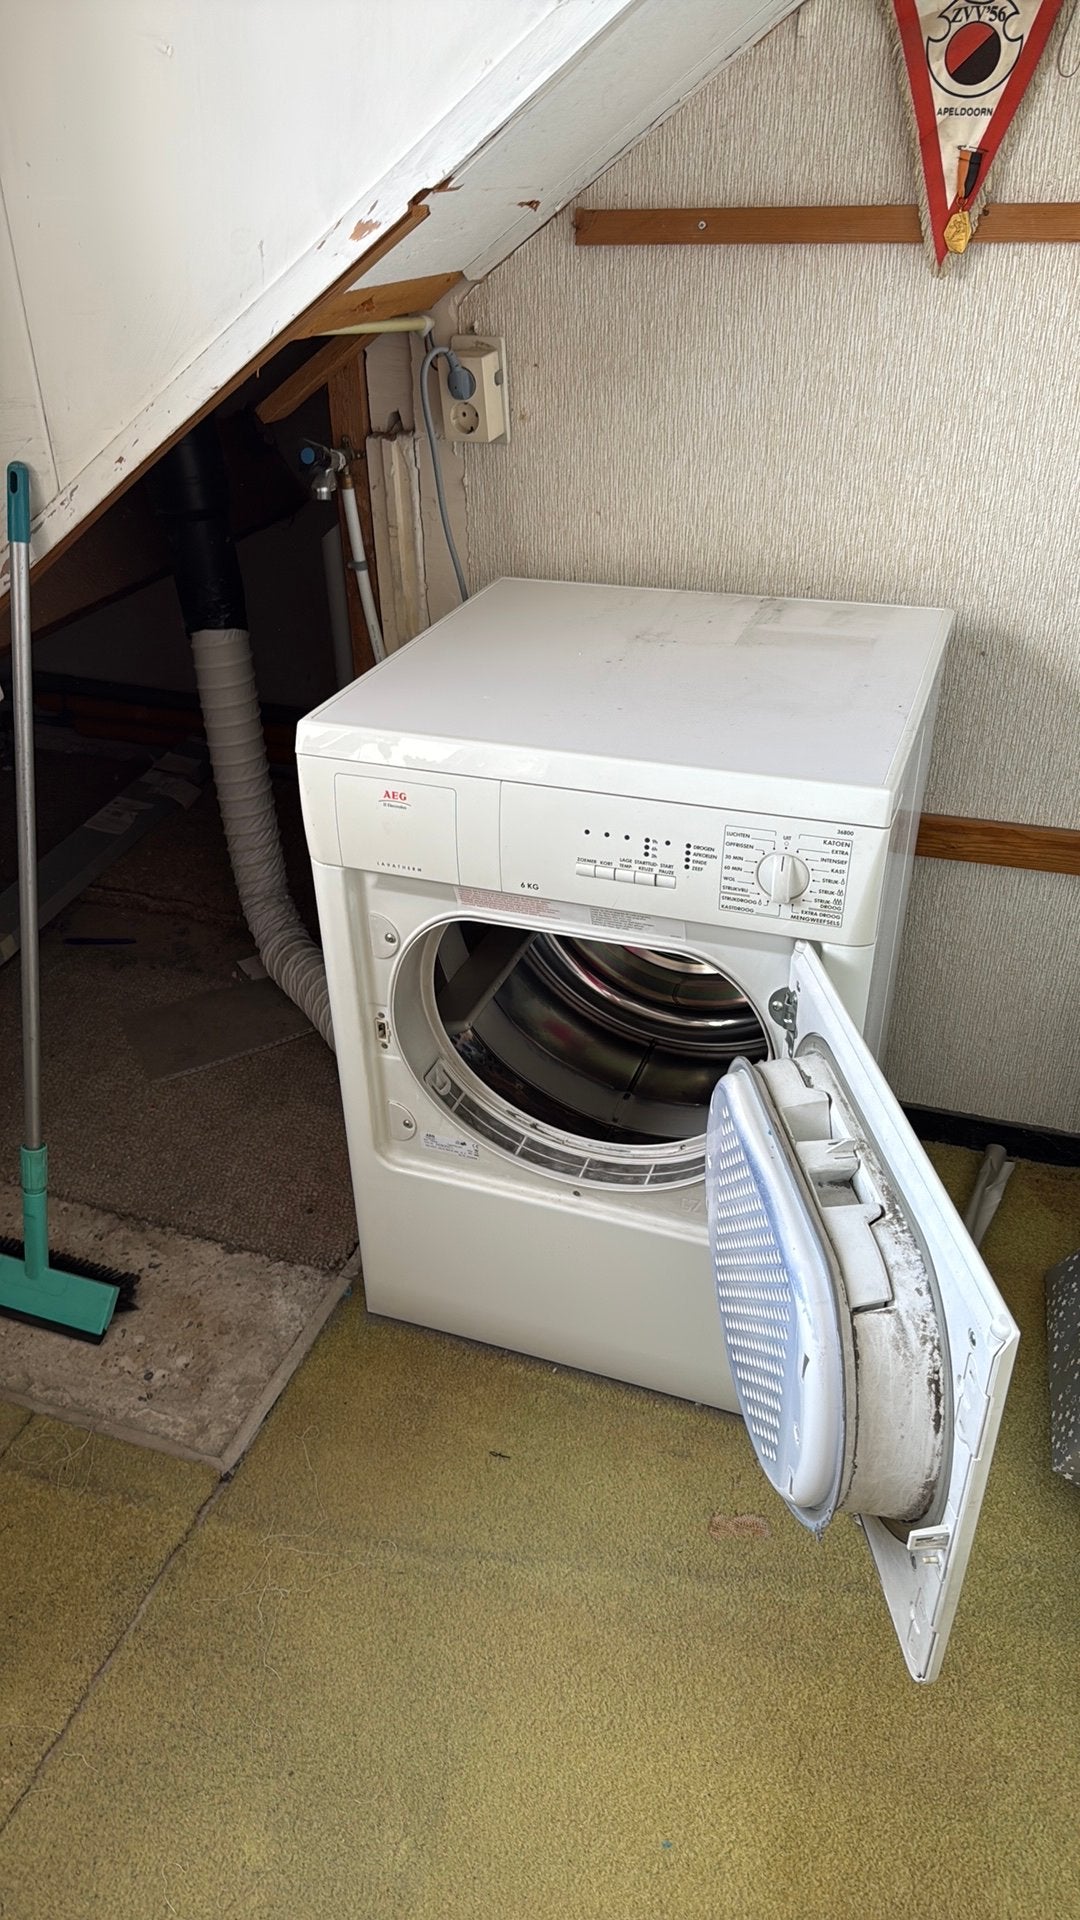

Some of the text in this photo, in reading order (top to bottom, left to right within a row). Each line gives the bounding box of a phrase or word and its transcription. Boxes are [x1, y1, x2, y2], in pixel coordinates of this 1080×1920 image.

[950, 5, 1007, 22] ZVV'56
[937, 107, 993, 116] APELDOORN
[384, 790, 407, 800] AEG
[726, 841, 754, 849] OPFRISSEN
[692, 852, 718, 860] AFKOELEN
[721, 904, 754, 913] KASTDROOG
[790, 914, 840, 926] MENGWEEFSELS
